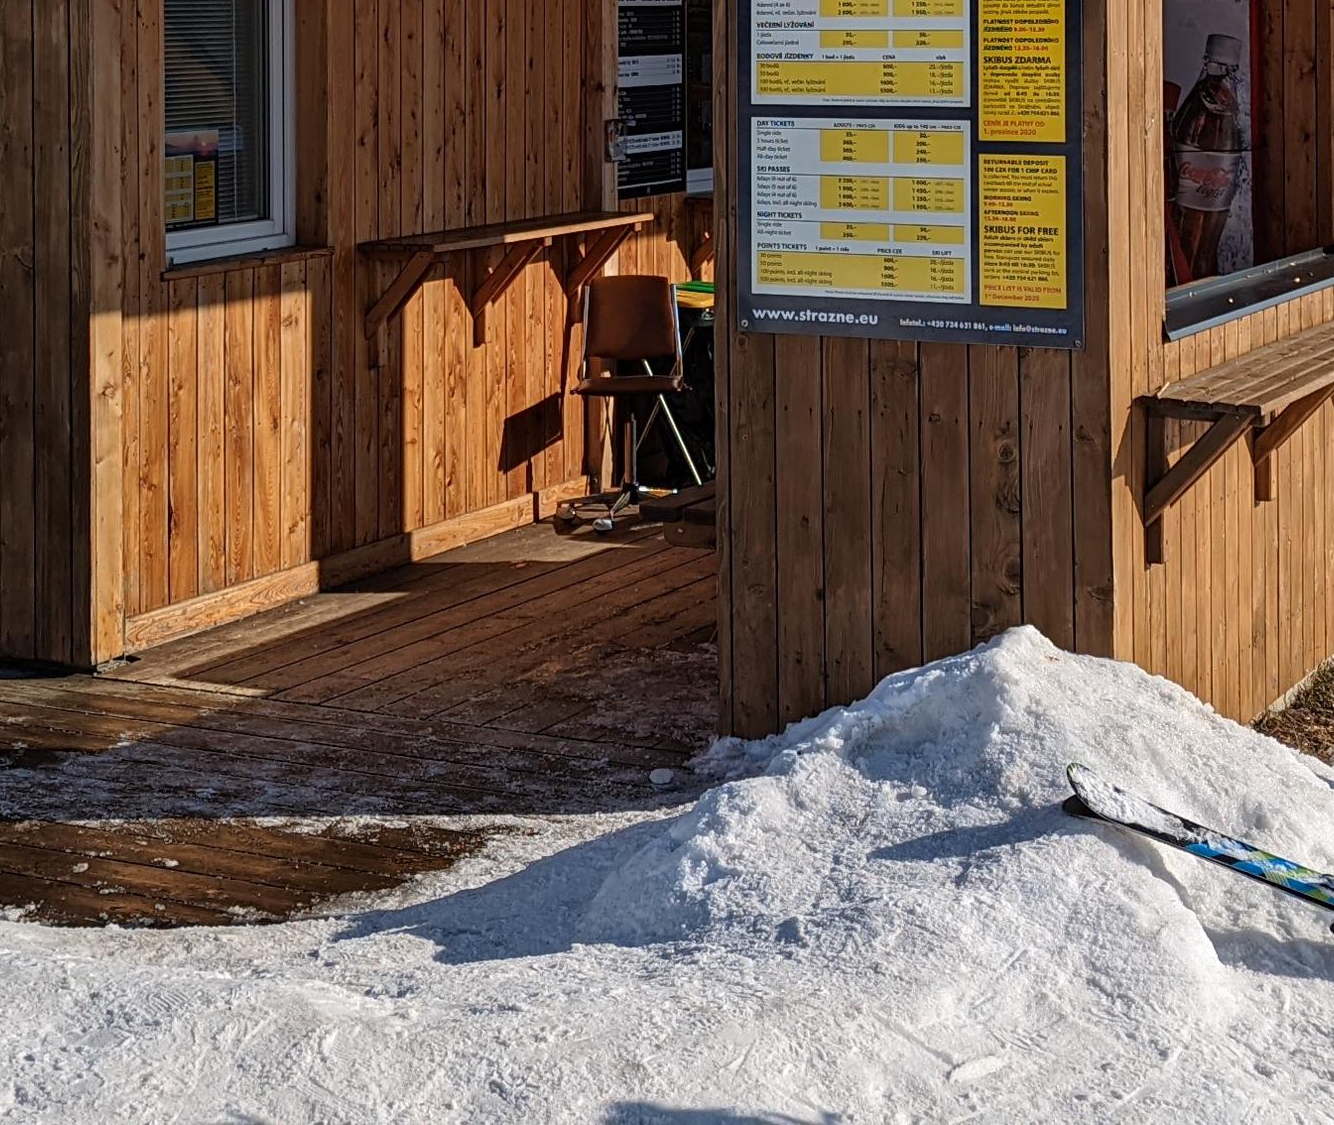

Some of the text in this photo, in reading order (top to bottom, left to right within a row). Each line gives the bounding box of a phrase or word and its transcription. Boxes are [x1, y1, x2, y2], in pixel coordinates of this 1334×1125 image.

[984, 226, 1059, 235] SKIBUS FOR FREE
[752, 309, 878, 325] www.strazne.eu
